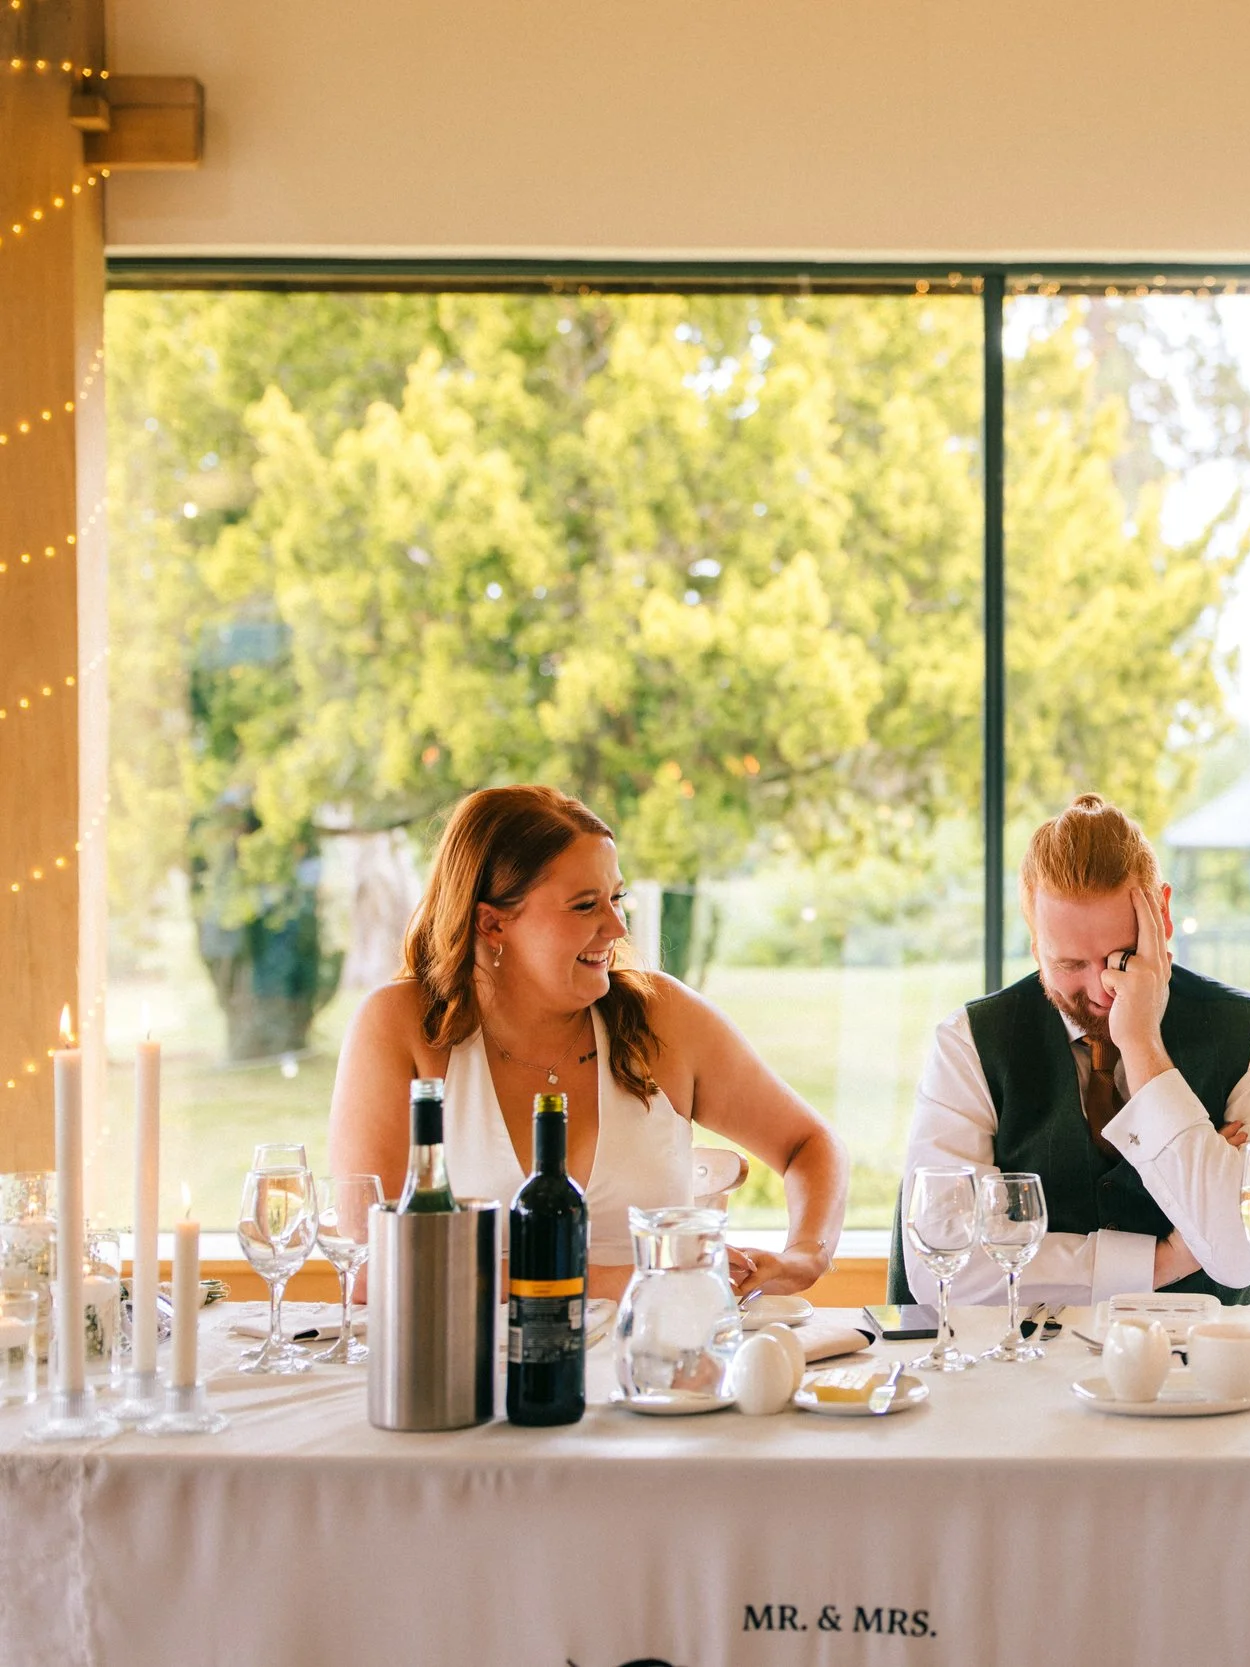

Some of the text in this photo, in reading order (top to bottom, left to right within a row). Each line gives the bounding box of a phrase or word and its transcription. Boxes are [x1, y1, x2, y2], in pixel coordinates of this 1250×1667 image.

[743, 1604, 937, 1638] MR. & MRS.
